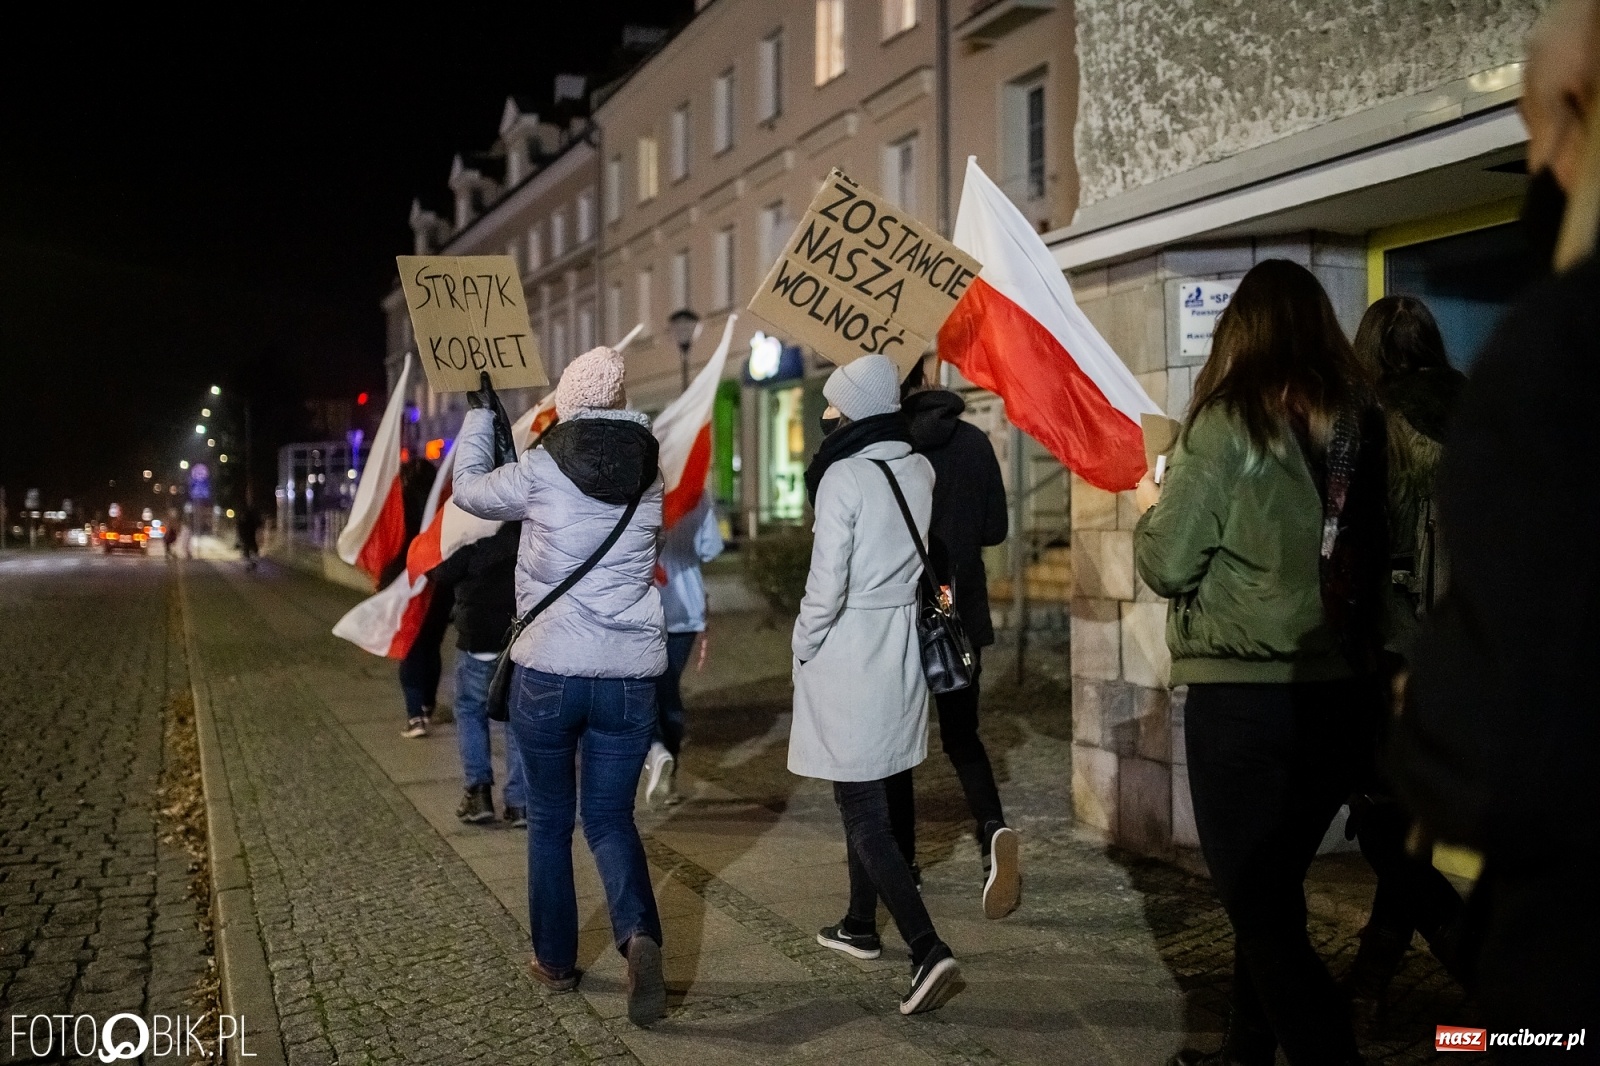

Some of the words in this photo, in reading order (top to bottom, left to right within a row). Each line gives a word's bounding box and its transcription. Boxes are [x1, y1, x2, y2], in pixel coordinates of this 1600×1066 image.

[819, 183, 975, 300] ZOSTAWCIE
[415, 265, 516, 328] STRAJK
[429, 334, 527, 371] KOBIET
